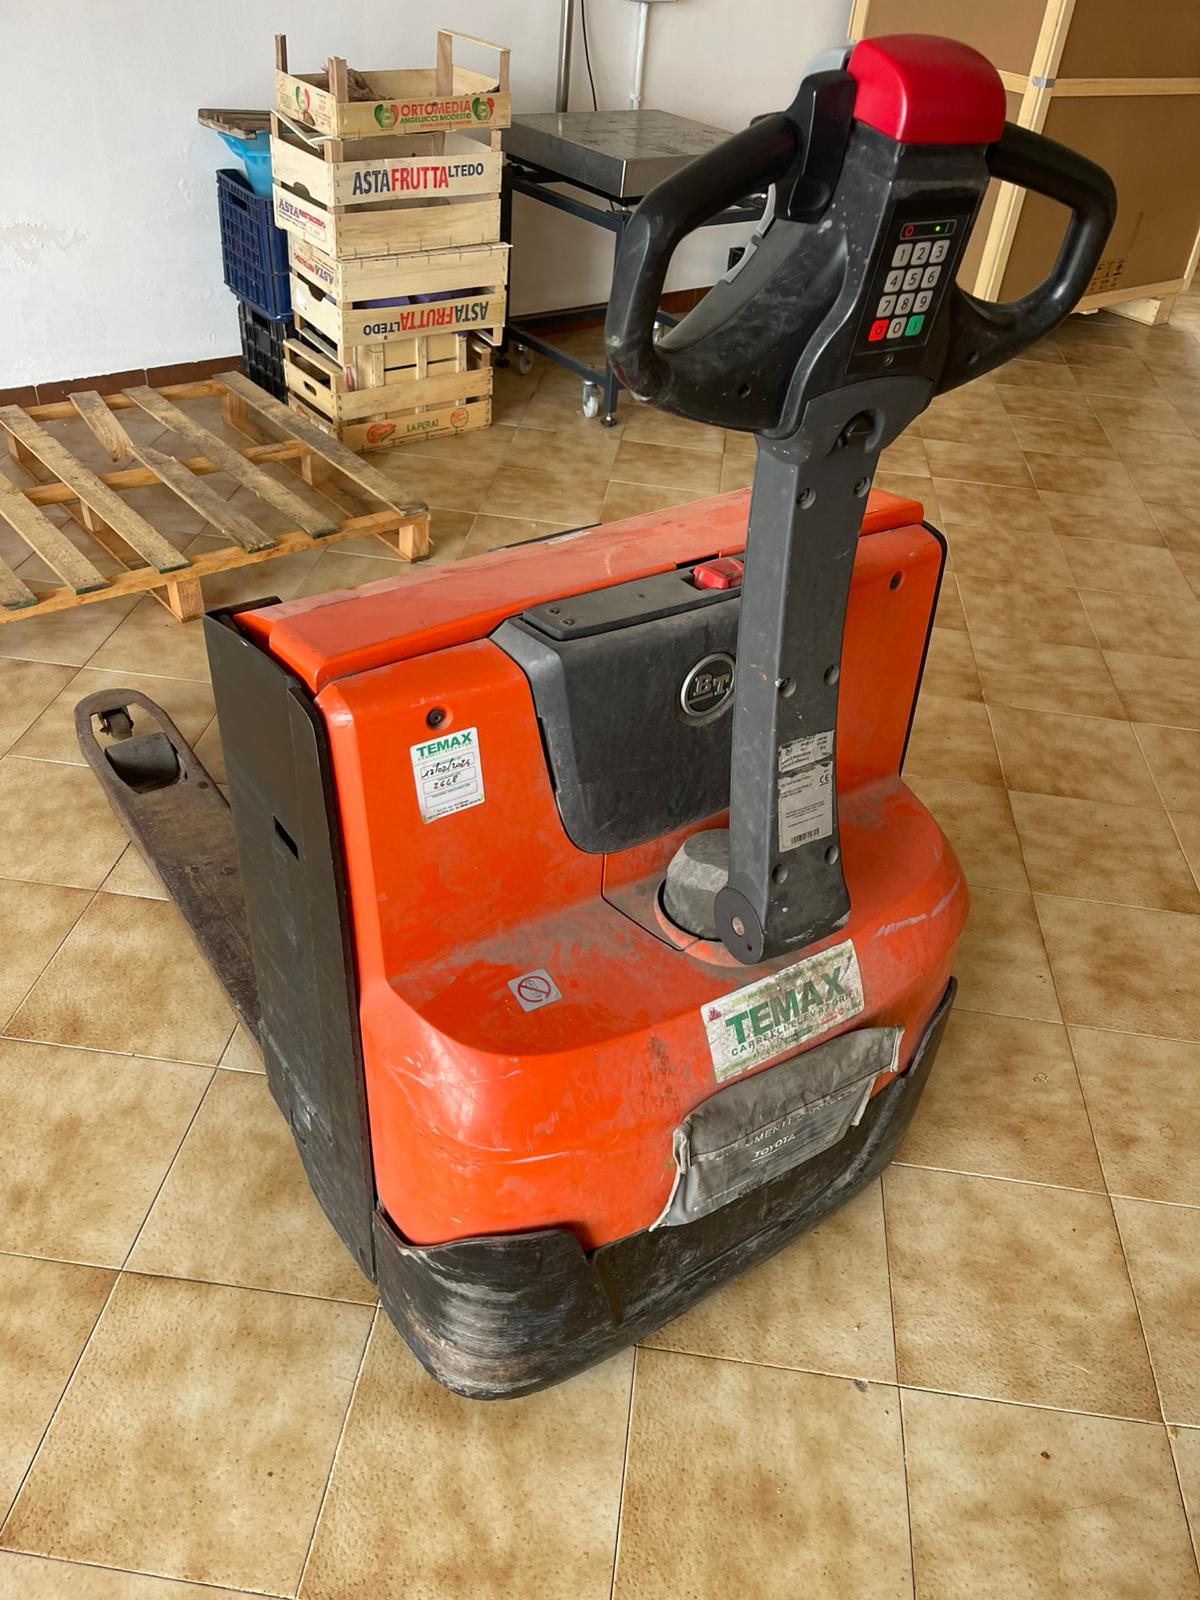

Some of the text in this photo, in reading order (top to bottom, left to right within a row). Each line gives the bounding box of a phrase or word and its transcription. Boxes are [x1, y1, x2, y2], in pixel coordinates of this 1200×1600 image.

[400, 101, 472, 117] ORTOMEDIA
[917, 246, 926, 260] 2
[935, 245, 944, 259] 3
[890, 270, 937, 287] 4 5 6
[882, 295, 928, 313] 7 8 9
[893, 321, 902, 334] 0
[693, 672, 731, 697] BT
[416, 731, 473, 758] TEMAX
[725, 965, 844, 1045] TEMAX
[754, 1133, 796, 1158] TOYOTA
